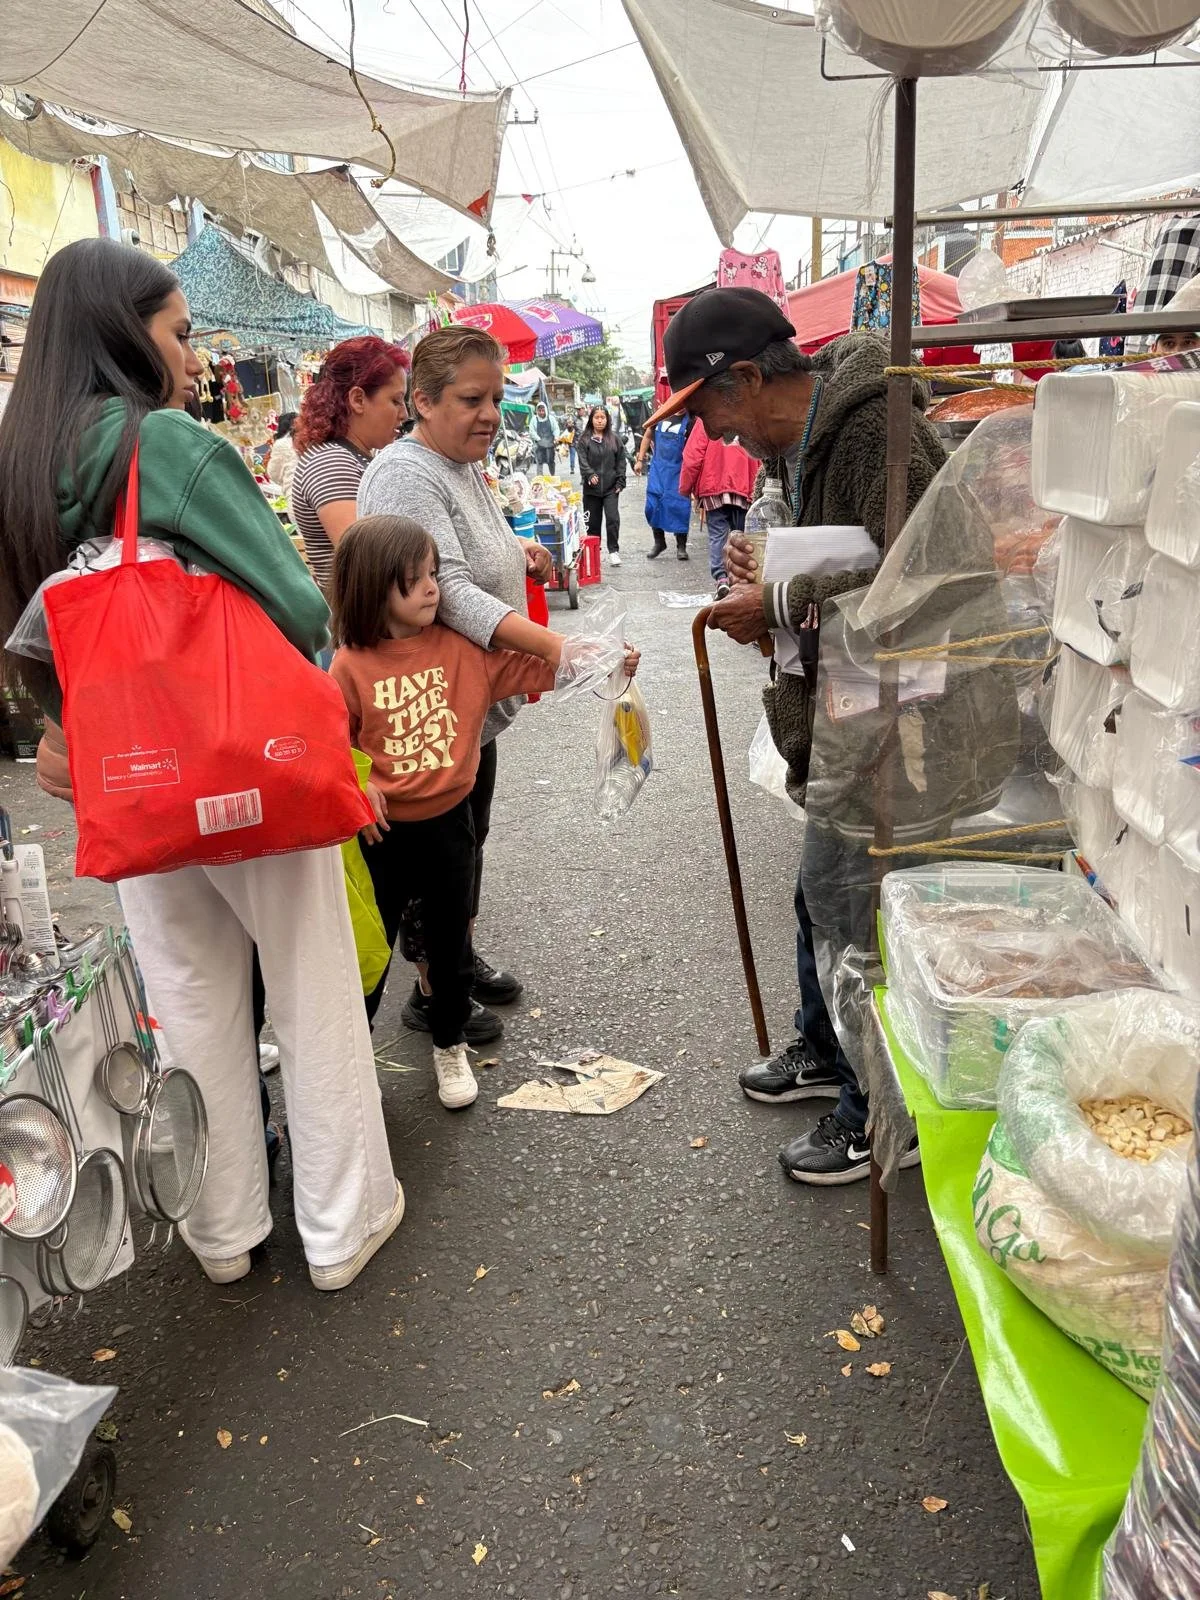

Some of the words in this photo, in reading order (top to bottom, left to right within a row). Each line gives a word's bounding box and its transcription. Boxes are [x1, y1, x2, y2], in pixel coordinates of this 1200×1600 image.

[373, 666, 449, 709] HAVE
[382, 708, 459, 756] BEST
[387, 686, 448, 736] THE
[130, 761, 162, 772] Walmart
[391, 737, 455, 775] DAY
